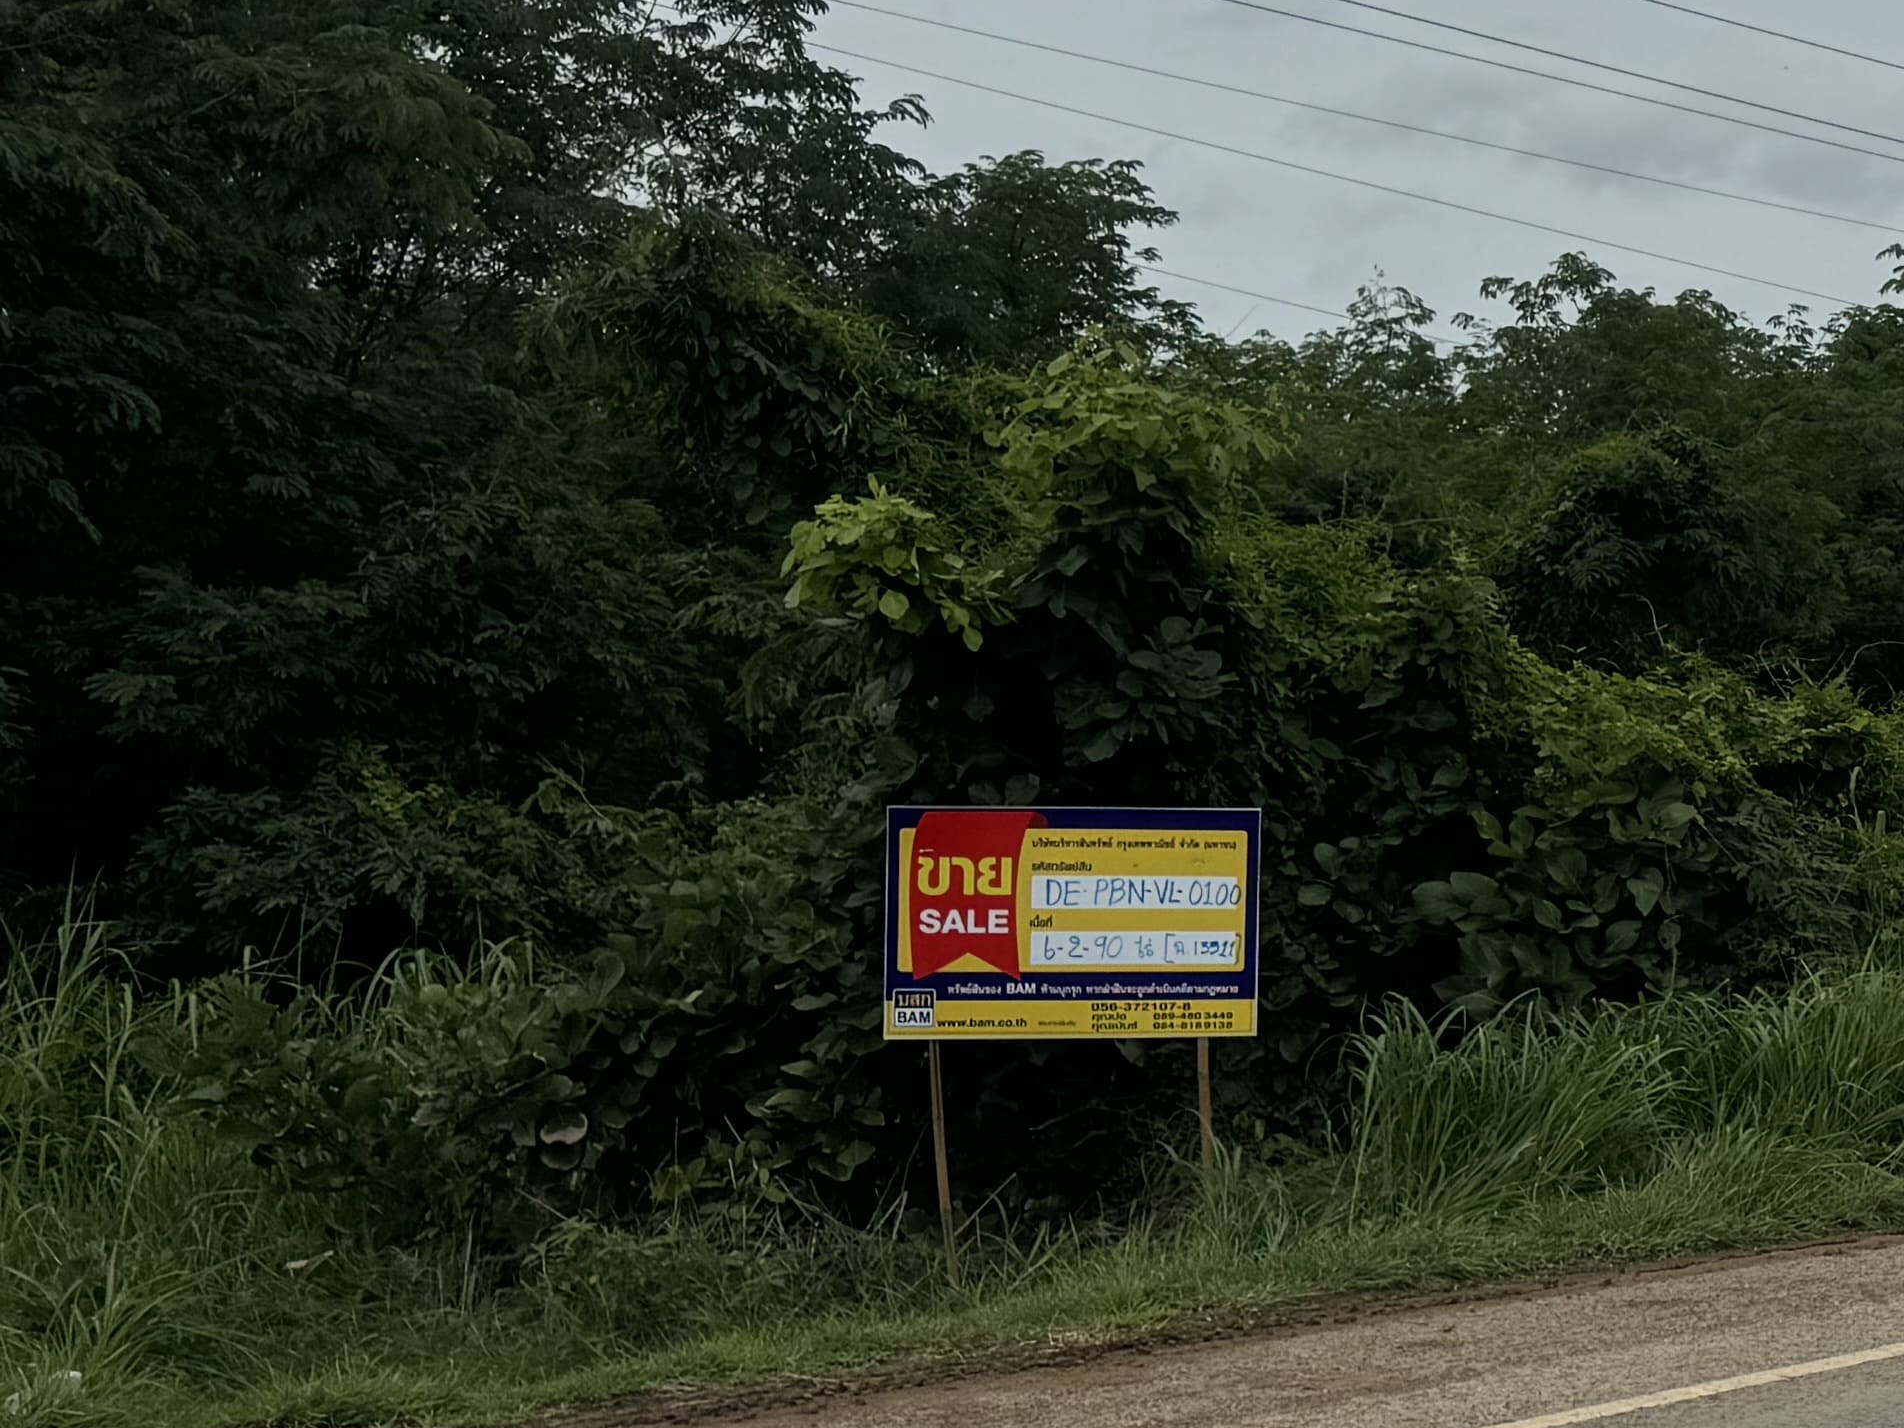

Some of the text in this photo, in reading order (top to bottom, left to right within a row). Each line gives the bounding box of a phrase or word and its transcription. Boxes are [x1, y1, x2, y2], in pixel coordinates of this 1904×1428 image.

[1180, 837, 1200, 849] จำกัด
[1204, 839, 1237, 850] (มหาชน)
[917, 856, 1013, 896] ขาย
[919, 908, 1009, 934] SALE
[1029, 914, 1053, 928] เนื้อที่
[1043, 935, 1124, 961] 6-2-90
[1006, 982, 1037, 995] BAM
[897, 1011, 931, 1024] BAM
[936, 1018, 1028, 1028] www.bam.co.th
